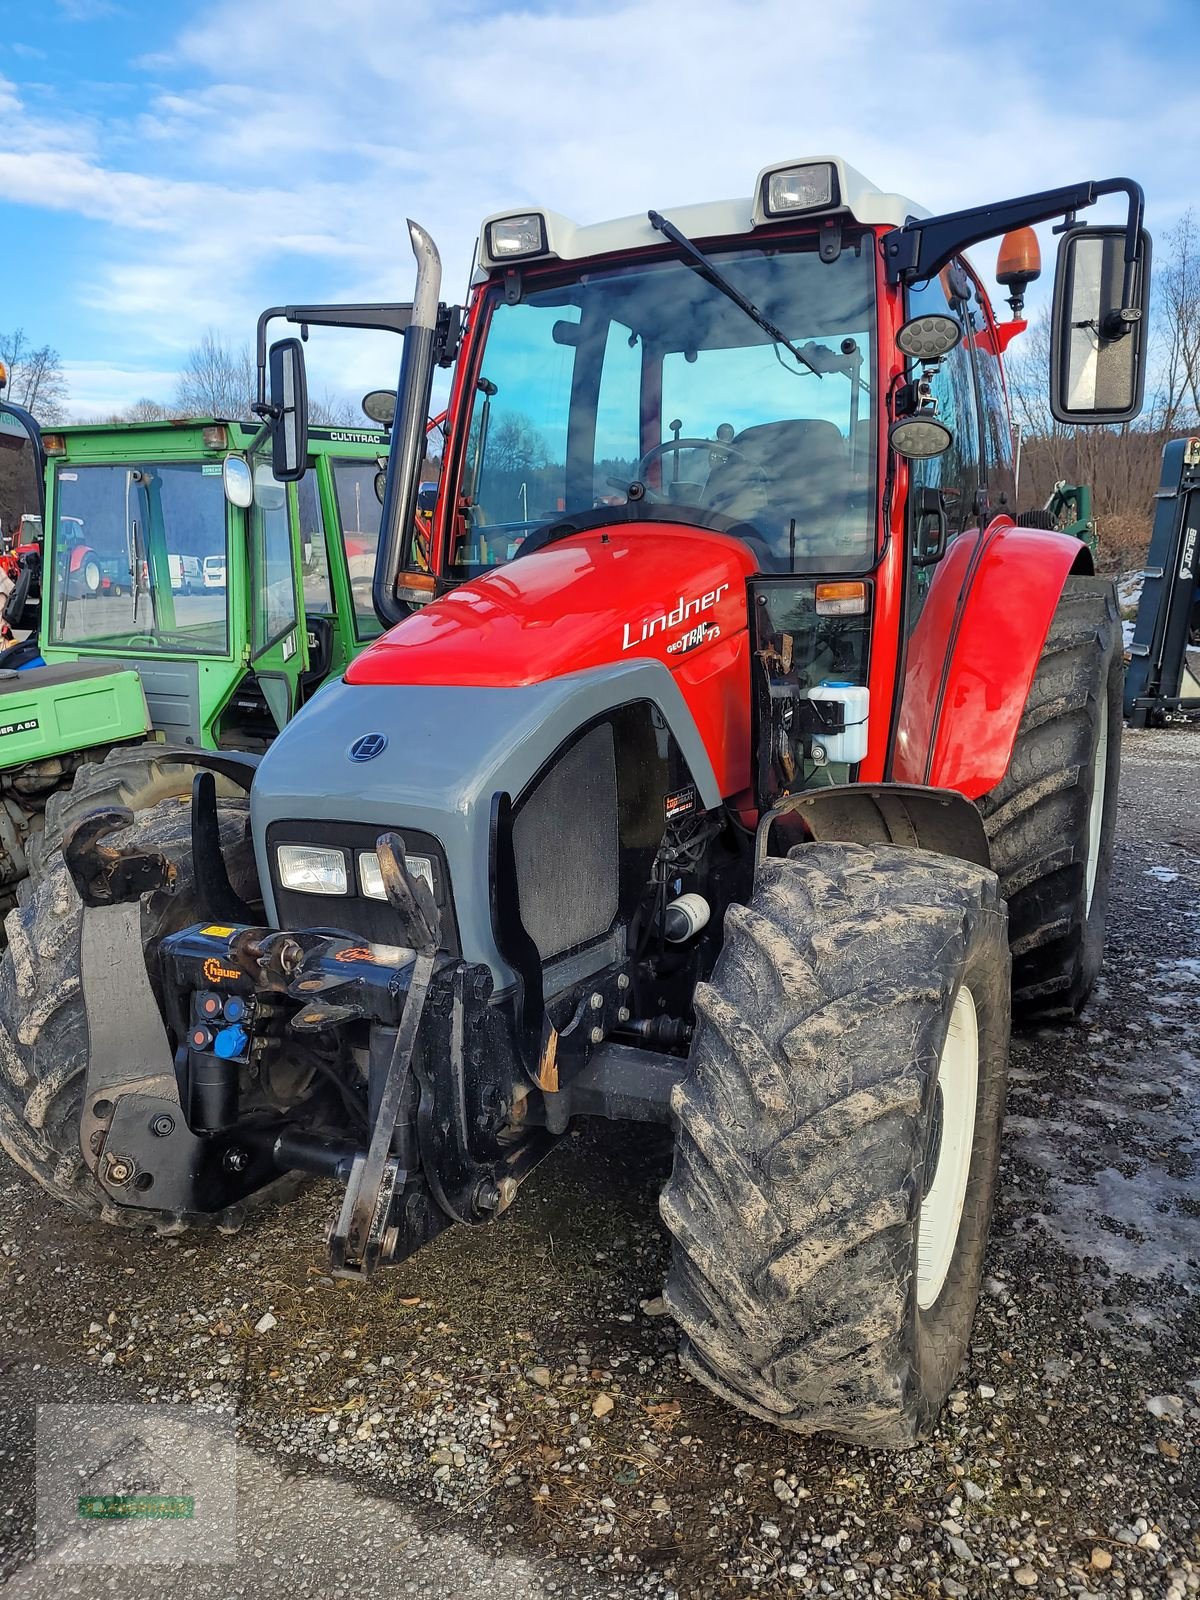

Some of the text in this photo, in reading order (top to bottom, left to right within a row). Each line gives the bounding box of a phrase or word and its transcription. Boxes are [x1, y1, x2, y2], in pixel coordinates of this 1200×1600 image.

[330, 432, 381, 444] CULTITRAC
[622, 582, 729, 651] Lindner
[707, 625, 721, 642] 73
[0, 726, 14, 736] ER
[209, 963, 241, 979] hauer
